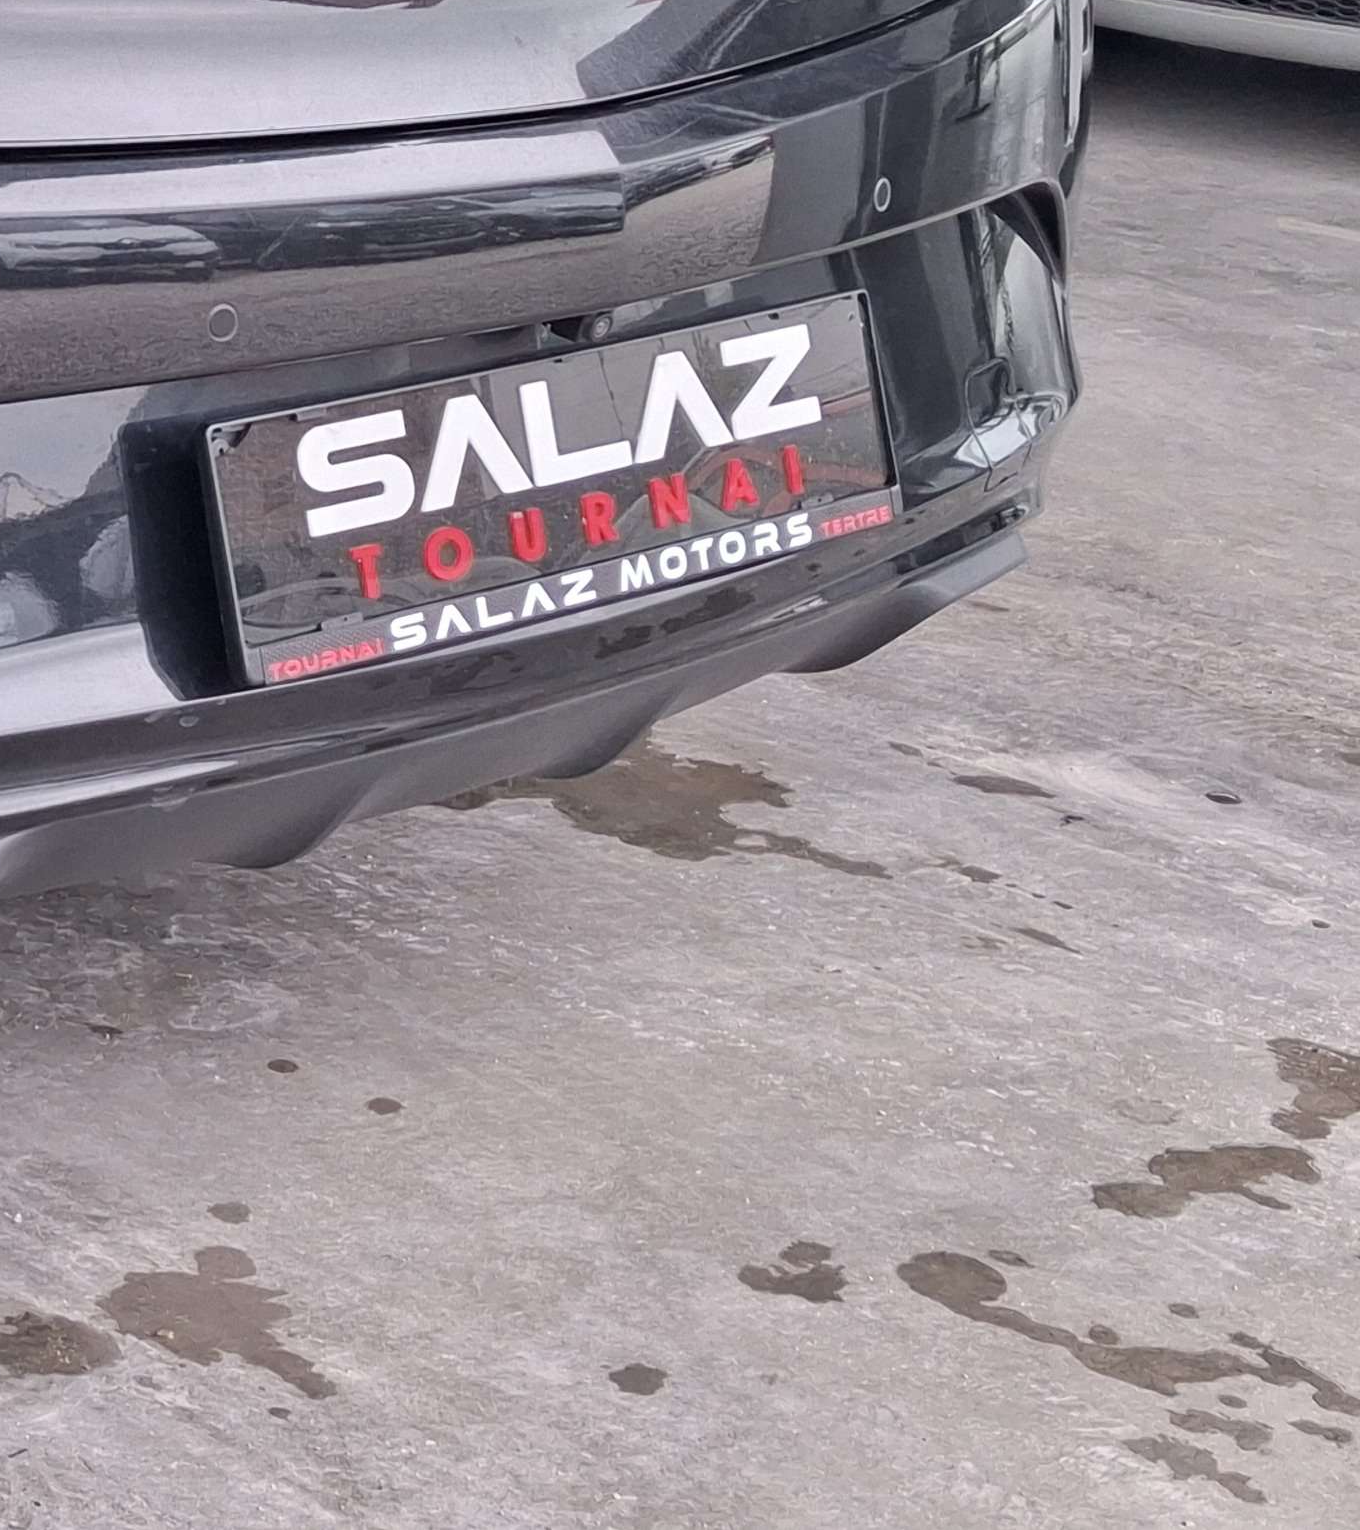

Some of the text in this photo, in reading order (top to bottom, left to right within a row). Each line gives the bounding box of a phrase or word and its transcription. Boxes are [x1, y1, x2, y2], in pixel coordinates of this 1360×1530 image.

[295, 323, 823, 538] SALAZ
[270, 504, 893, 682] TOURNAI SALAZ MOTORS TERTRE
[347, 444, 806, 600] TOURNAI
